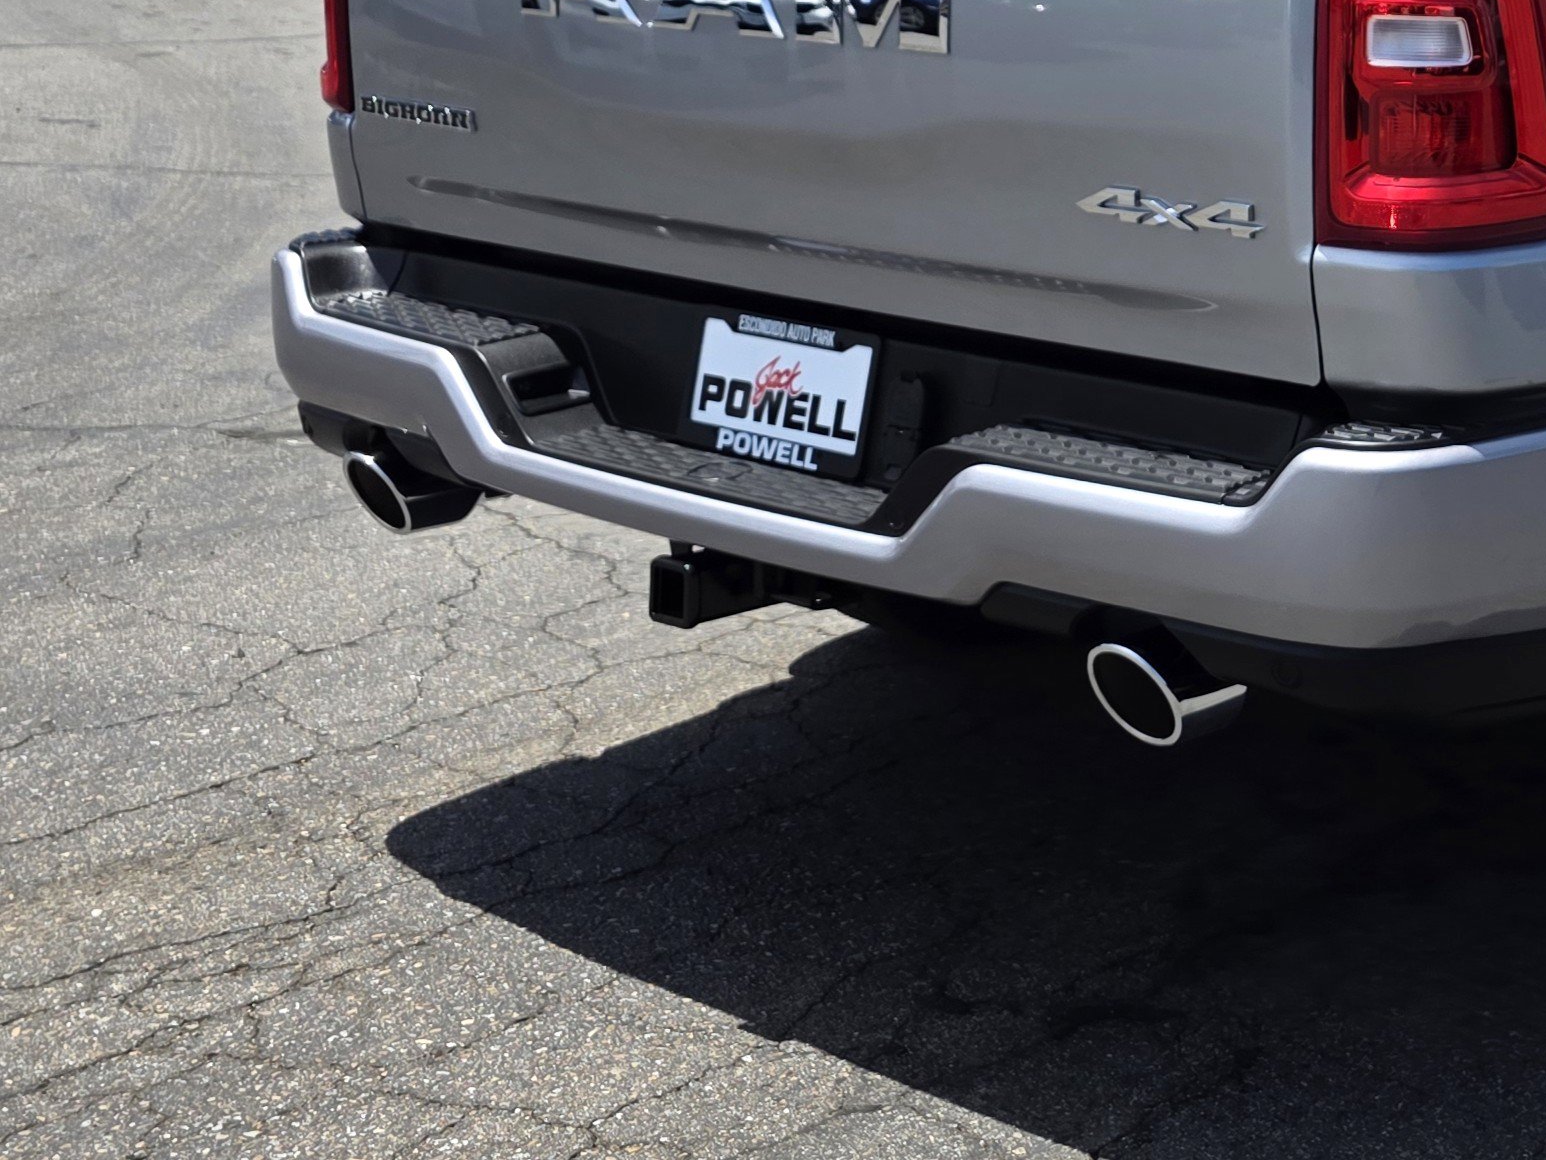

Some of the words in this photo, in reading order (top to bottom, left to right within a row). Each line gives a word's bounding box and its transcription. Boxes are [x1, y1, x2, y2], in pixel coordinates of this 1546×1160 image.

[787, 323, 811, 341] AUTO
[811, 327, 835, 347] PARK
[698, 373, 857, 442] POWELL
[716, 427, 818, 471] POWELL
